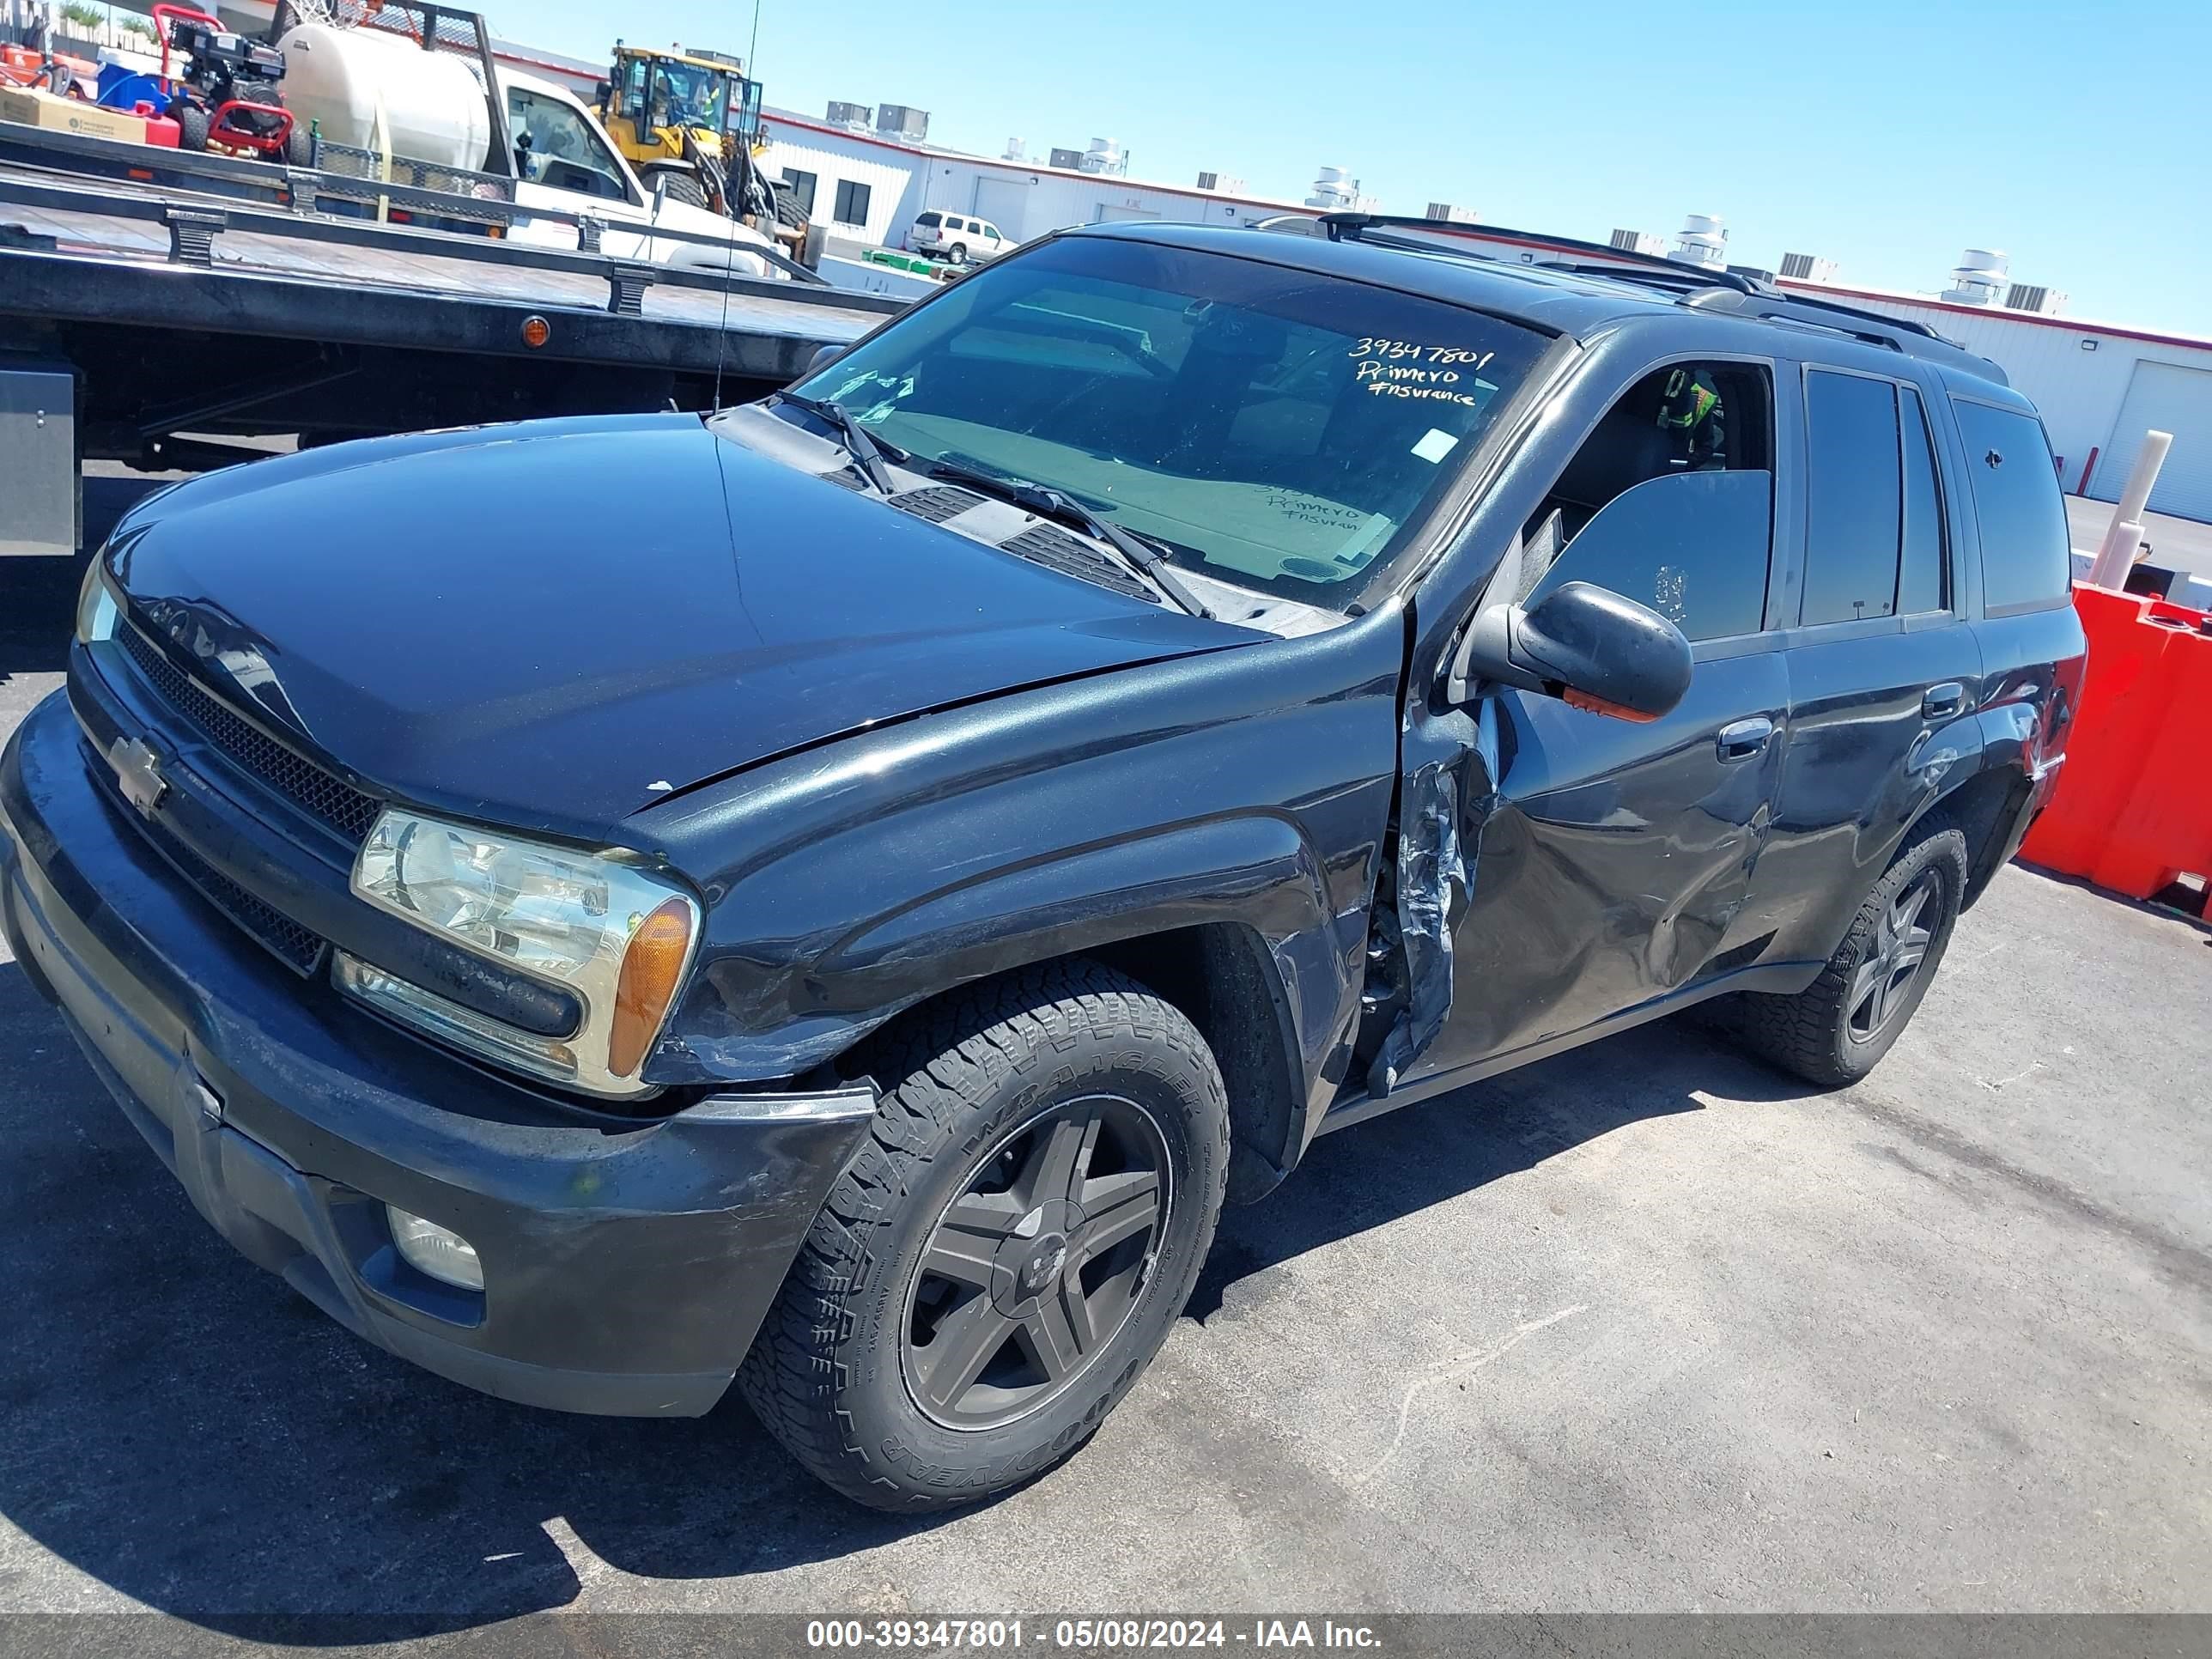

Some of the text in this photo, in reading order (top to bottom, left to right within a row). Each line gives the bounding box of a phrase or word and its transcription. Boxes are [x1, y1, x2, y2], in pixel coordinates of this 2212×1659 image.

[1355, 360, 1460, 383] Primero
[960, 1048, 1203, 1156] WRANGLER
[879, 1356, 1140, 1488] GOODYEAR
